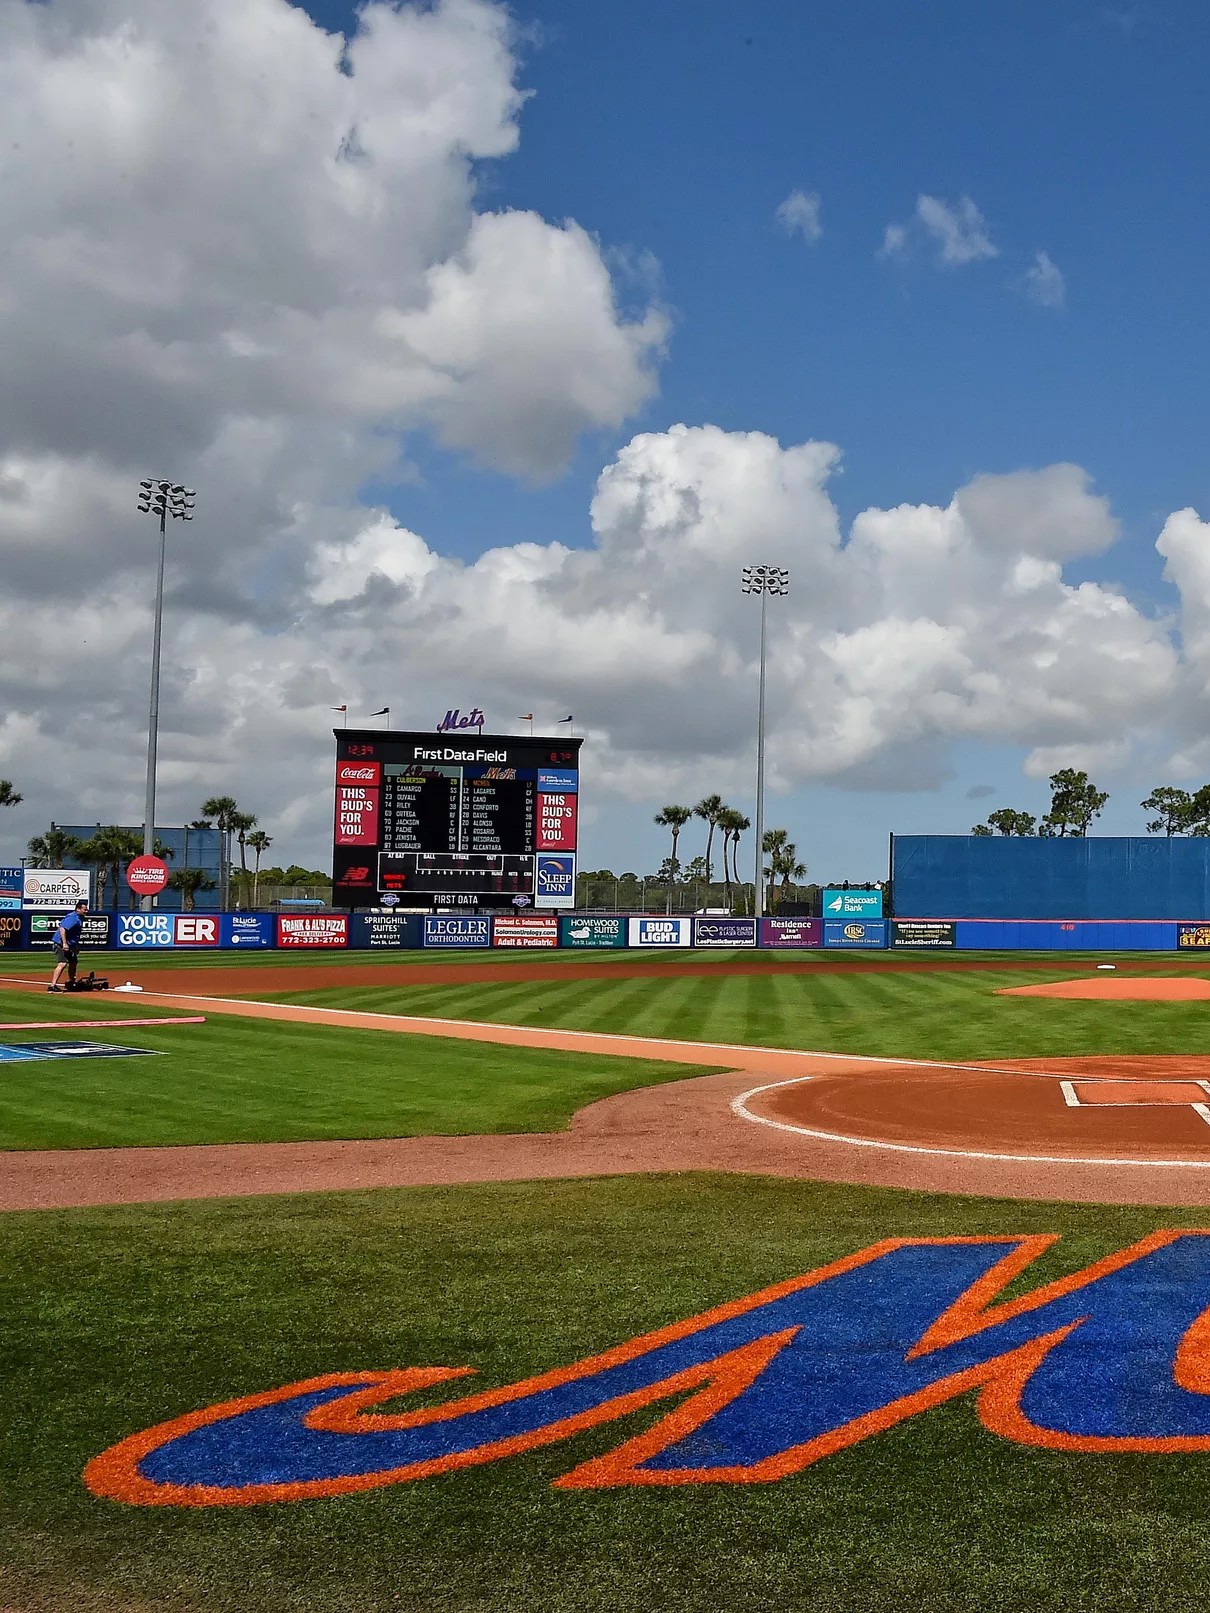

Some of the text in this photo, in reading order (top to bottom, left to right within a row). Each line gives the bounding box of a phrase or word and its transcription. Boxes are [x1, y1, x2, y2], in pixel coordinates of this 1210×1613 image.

[437, 708, 485, 731] Mets
[414, 748, 507, 762] First Data Field
[341, 788, 365, 799] THIS
[341, 800, 373, 811] BUD'S
[542, 795, 565, 806] THIS
[340, 812, 361, 823] FOR
[542, 806, 572, 818] BUD'S
[340, 824, 365, 835] YOU.
[542, 819, 561, 829] FOR
[542, 830, 564, 840] YOU.
[538, 870, 571, 885] SLEEP
[40, 884, 76, 893] CARPETS
[434, 895, 478, 904] FIRST DATA
[844, 896, 877, 904] Seacoast
[121, 916, 167, 929] YOUR
[281, 919, 345, 932] FRANK & AL'S PIZZA
[427, 921, 487, 934] LEGLER
[647, 923, 673, 932] BUD
[177, 919, 215, 940] ER
[496, 928, 556, 936] SolomonUrology.com
[120, 931, 171, 945] GO-TO
[641, 932, 678, 942] LIGHT
